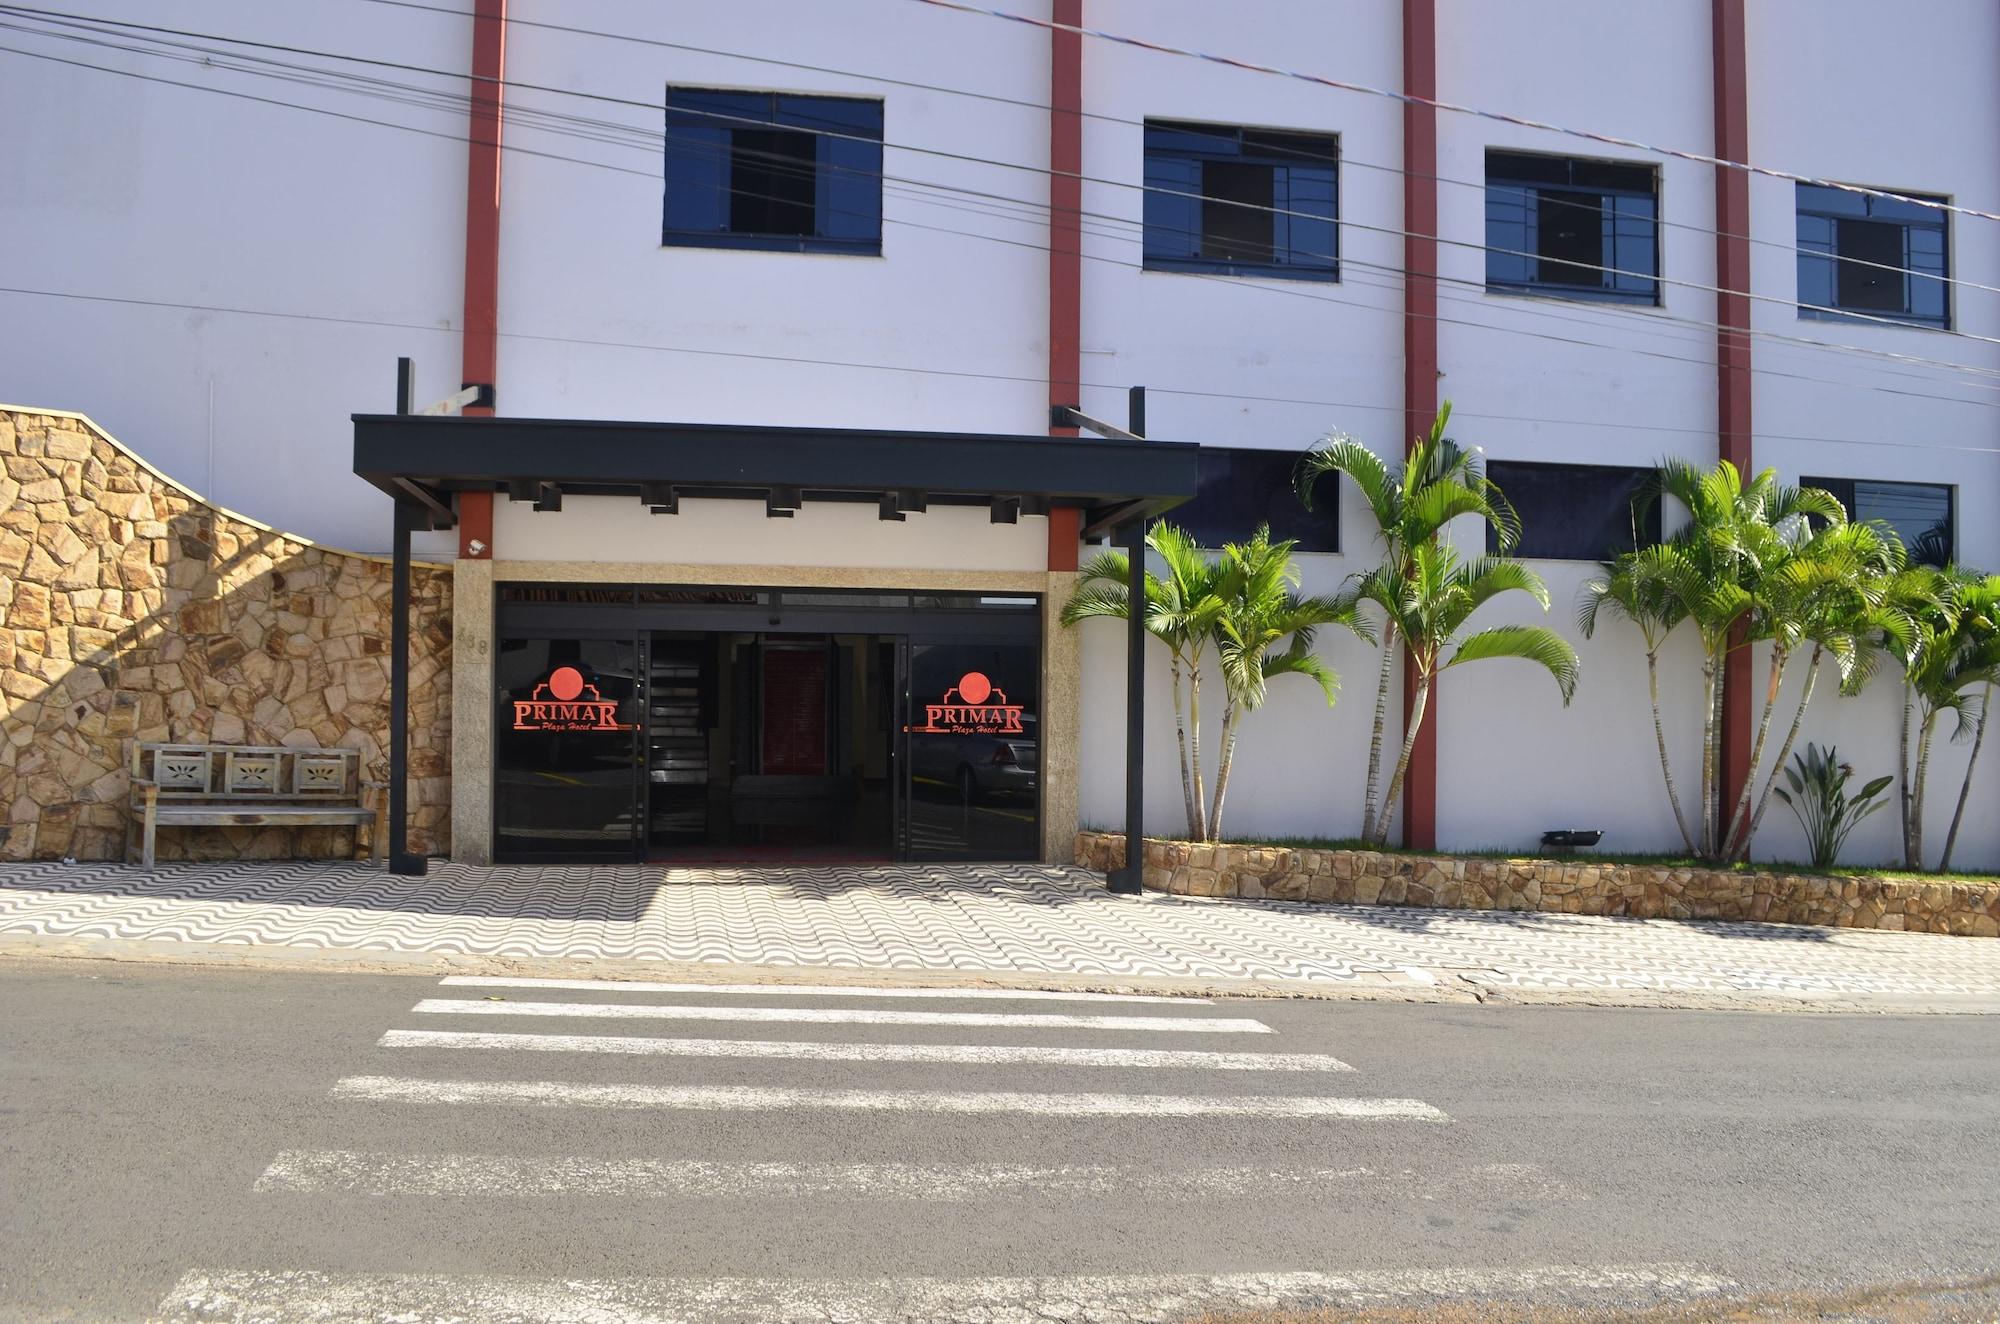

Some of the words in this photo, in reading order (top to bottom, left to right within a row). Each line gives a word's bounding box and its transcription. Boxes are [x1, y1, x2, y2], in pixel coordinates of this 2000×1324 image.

[514, 704, 618, 727] PRIMAR
[926, 708, 1023, 729] PRIMAR
[541, 722, 566, 732] Plaza
[567, 722, 592, 731] Hotel
[951, 725, 974, 735] Plaza
[975, 725, 998, 734] Hotel
